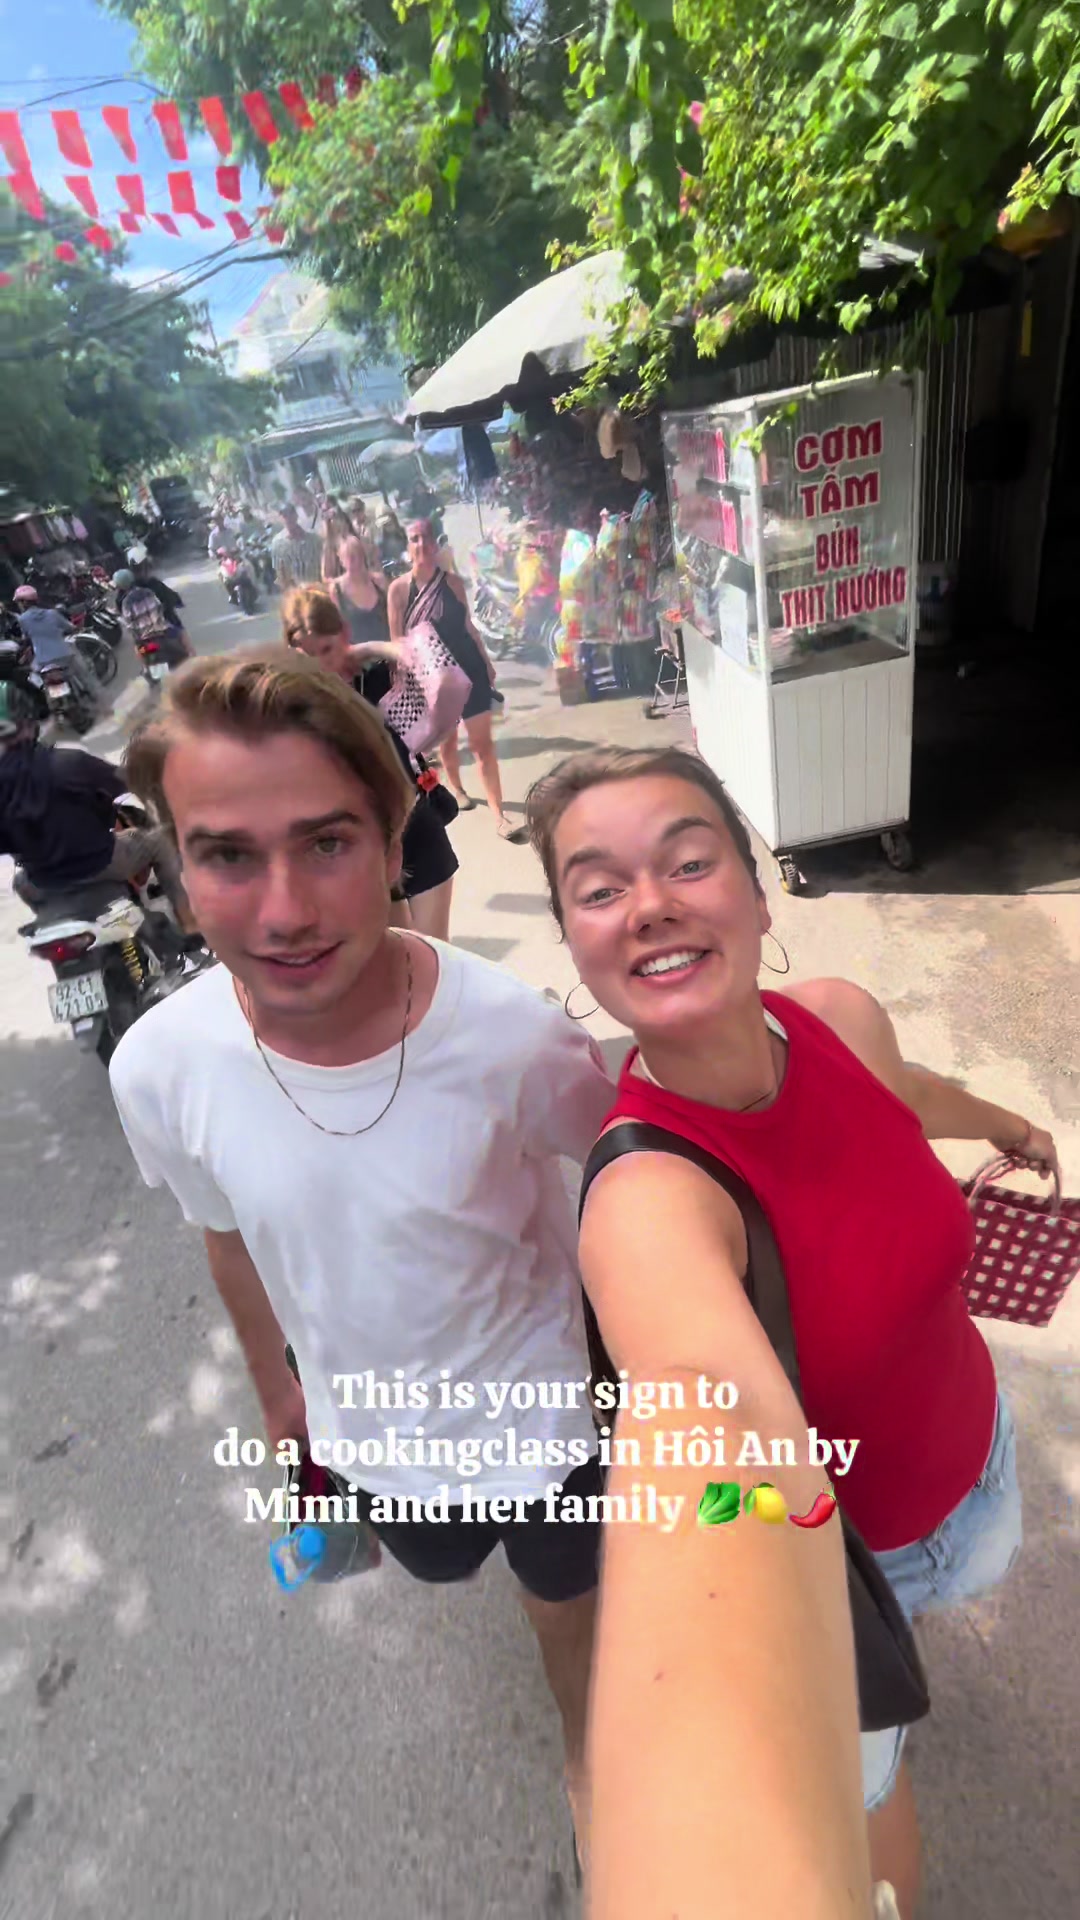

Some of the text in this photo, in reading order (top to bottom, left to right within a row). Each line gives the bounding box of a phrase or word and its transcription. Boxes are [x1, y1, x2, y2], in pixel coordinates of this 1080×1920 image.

[795, 417, 883, 472] CƠM
[798, 465, 880, 519] TẤM
[815, 520, 861, 574] BÚN
